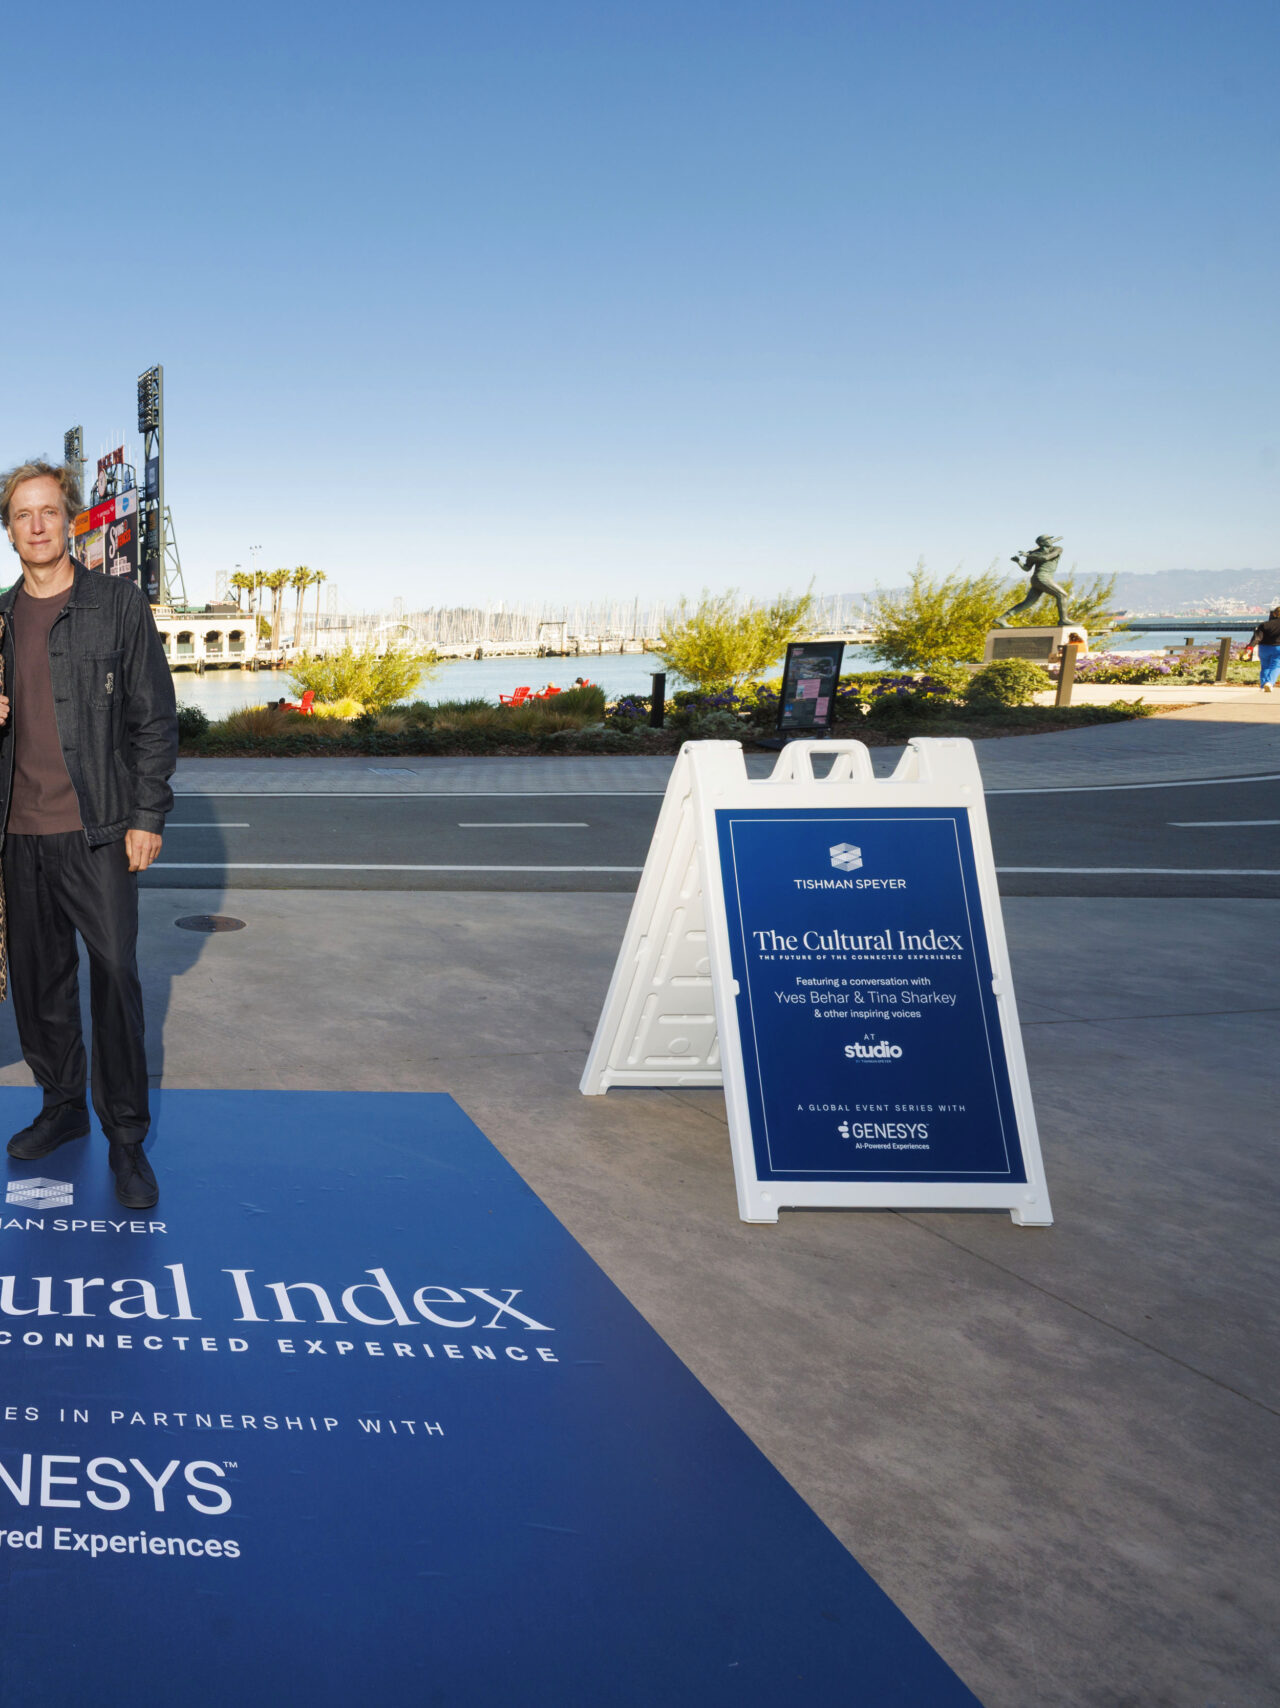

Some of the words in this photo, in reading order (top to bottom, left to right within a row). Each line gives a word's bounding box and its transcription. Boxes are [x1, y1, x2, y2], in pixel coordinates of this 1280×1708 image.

[794, 879, 854, 890] TISHMAN
[856, 878, 907, 889] SPEYER
[752, 929, 799, 951] The
[802, 929, 893, 951] Cultural
[898, 928, 964, 951] Index
[796, 976, 839, 988] Featuring
[841, 978, 848, 986] a
[849, 977, 908, 986] conversation
[910, 976, 931, 986] with
[774, 991, 807, 1004] Yves
[810, 990, 850, 1004] Behar
[854, 990, 865, 1004] &
[867, 990, 897, 1004] Tina
[901, 990, 957, 1007] Sharkey
[814, 1008, 822, 1018] &
[824, 1009, 848, 1018] other
[850, 1009, 890, 1020] inspiring
[892, 1010, 922, 1018] voices
[863, 1033, 875, 1041] AT
[844, 1040, 903, 1059] studio
[808, 1104, 850, 1112] GLOBAL
[855, 1104, 889, 1112] EVENT
[894, 1104, 933, 1112] SERIES
[938, 1104, 966, 1112] WITH
[852, 1122, 929, 1139] GENESYS
[855, 1142, 892, 1150] AI-Powered
[892, 1142, 930, 1151] Experiences
[53, 1219, 168, 1234] SPEYER
[221, 1267, 556, 1331] Index
[277, 1339, 559, 1362] EXPERIENCE
[60, 1408, 89, 1423] IN
[111, 1410, 338, 1431] PARTNERSHIP
[358, 1418, 445, 1436] WITH
[54, 1527, 241, 1558] Experiences
